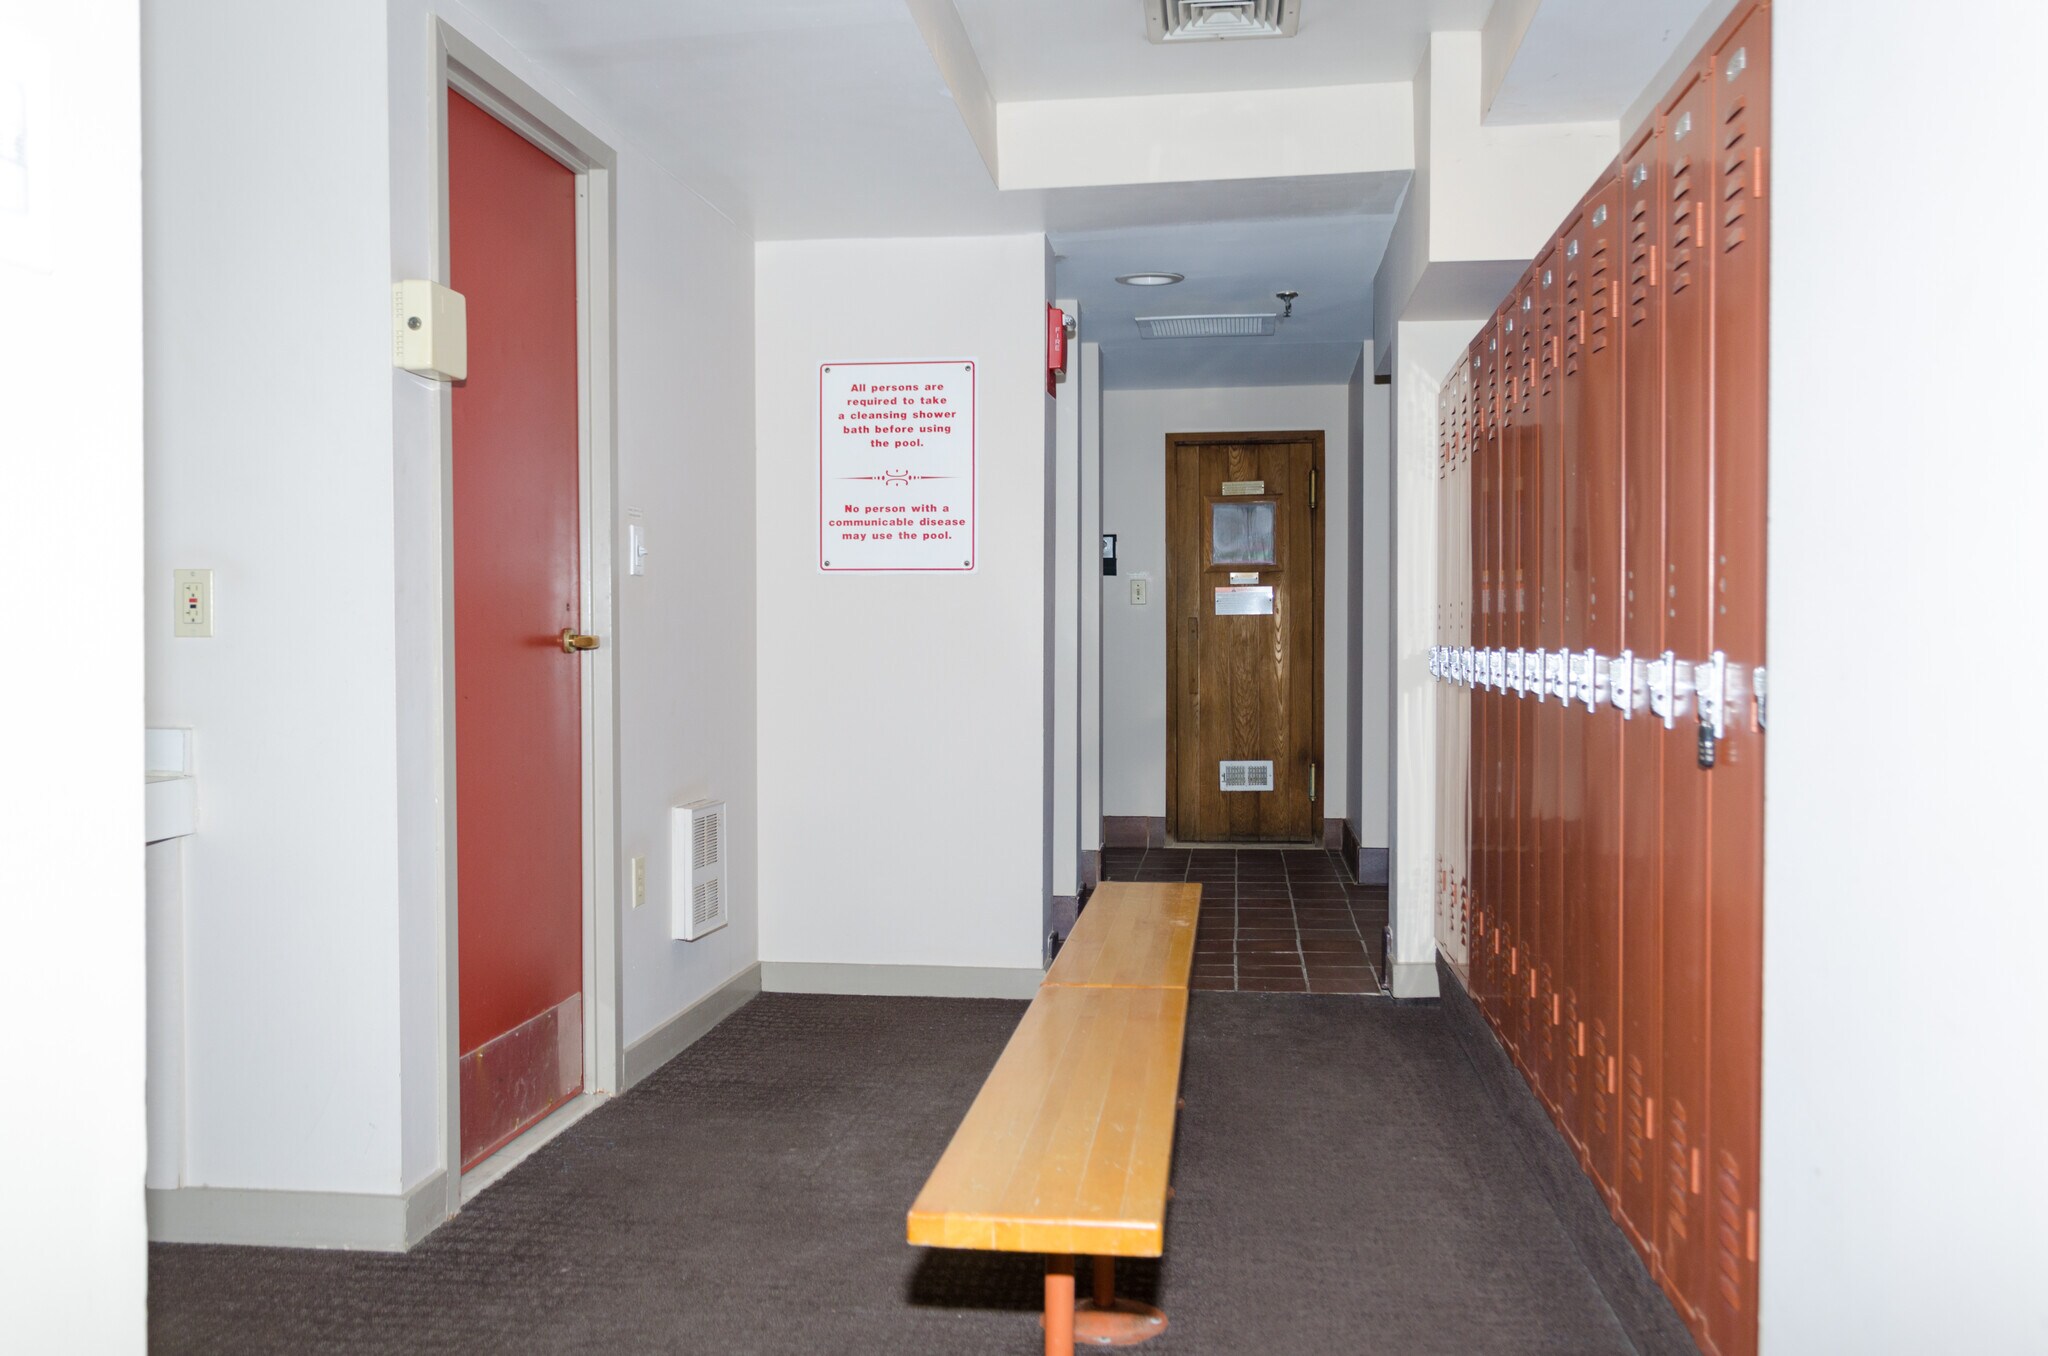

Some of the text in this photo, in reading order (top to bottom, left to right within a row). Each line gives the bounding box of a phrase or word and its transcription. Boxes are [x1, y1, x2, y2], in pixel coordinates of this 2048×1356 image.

[851, 384, 866, 392] All
[871, 385, 919, 394] persons
[847, 397, 897, 407] required
[920, 397, 947, 405] take
[850, 411, 907, 420] cleansing
[913, 410, 956, 418] shower
[843, 425, 951, 434] bath before using
[871, 438, 924, 448] the pool.
[844, 505, 859, 513] No
[865, 506, 906, 514] person
[912, 504, 937, 512] with
[828, 518, 966, 527] communicable disease
[842, 533, 866, 541] may
[898, 531, 917, 540] the
[922, 531, 952, 540] pool.
